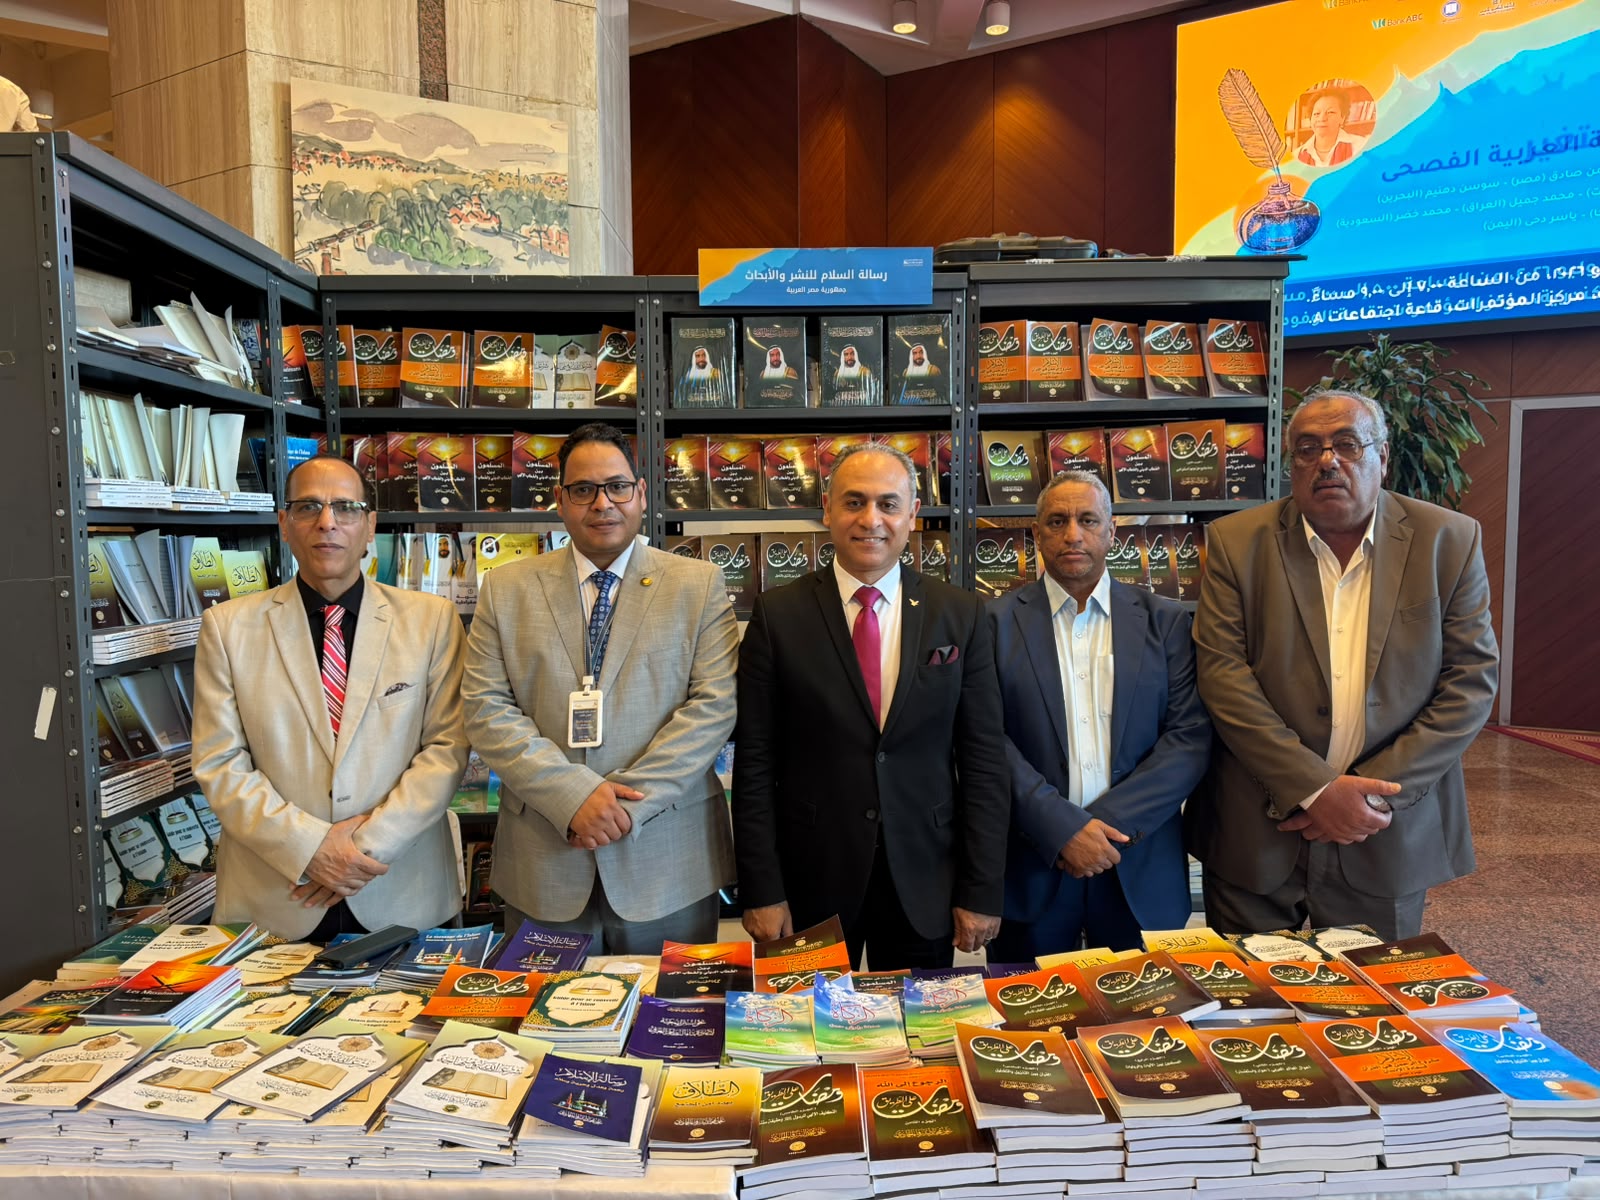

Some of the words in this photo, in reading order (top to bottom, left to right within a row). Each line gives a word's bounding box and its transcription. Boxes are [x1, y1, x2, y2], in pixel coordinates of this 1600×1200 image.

[1382, 148, 1479, 182] الفصحى
[1511, 174, 1546, 187] (مصر)
[1549, 170, 1582, 181] صادق
[1425, 185, 1456, 198] دهنيم
[1459, 181, 1500, 194] سوسن
[1377, 190, 1423, 204] (البحرين)
[1509, 196, 1540, 209] جميل
[1542, 191, 1574, 203] محمد
[1422, 206, 1452, 217] محمد
[1462, 199, 1506, 214] (العراق)
[1336, 214, 1393, 229] (السعودية)
[1394, 210, 1419, 222] خضر
[1549, 212, 1577, 224] ياسر
[1483, 218, 1522, 231] (اليمن)
[744, 267, 786, 283] والأبحاث
[788, 269, 818, 283] للنشر
[820, 268, 855, 283] السلام
[858, 268, 888, 282] رسالة
[1515, 270, 1540, 286] من
[786, 286, 805, 294] العربية
[804, 286, 820, 294] مصر
[820, 286, 847, 294] جمهورية
[1388, 279, 1412, 299] إلى
[1064, 457, 1089, 465] المسلمون
[1126, 454, 1152, 462] المسلمون
[430, 462, 458, 470] المسلمون
[721, 464, 746, 472] المسلمون
[1096, 959, 1172, 994] ومضات
[1268, 963, 1349, 983] ومضات
[454, 971, 529, 994] ومضات
[997, 974, 1077, 1006] ومضات
[923, 988, 967, 1009] الزكاة
[745, 1007, 794, 1027] الزكاة
[831, 1003, 876, 1025] الزكاة
[1323, 1018, 1417, 1049] ومضات
[1444, 1025, 1546, 1052] ومضات
[1096, 1026, 1187, 1058] ومضات
[1209, 1033, 1306, 1062] ومضات
[970, 1035, 1061, 1066] ومضات
[672, 1080, 740, 1099] الطلاق
[760, 1073, 844, 1113] ومضات
[872, 1085, 964, 1119] ومضات
